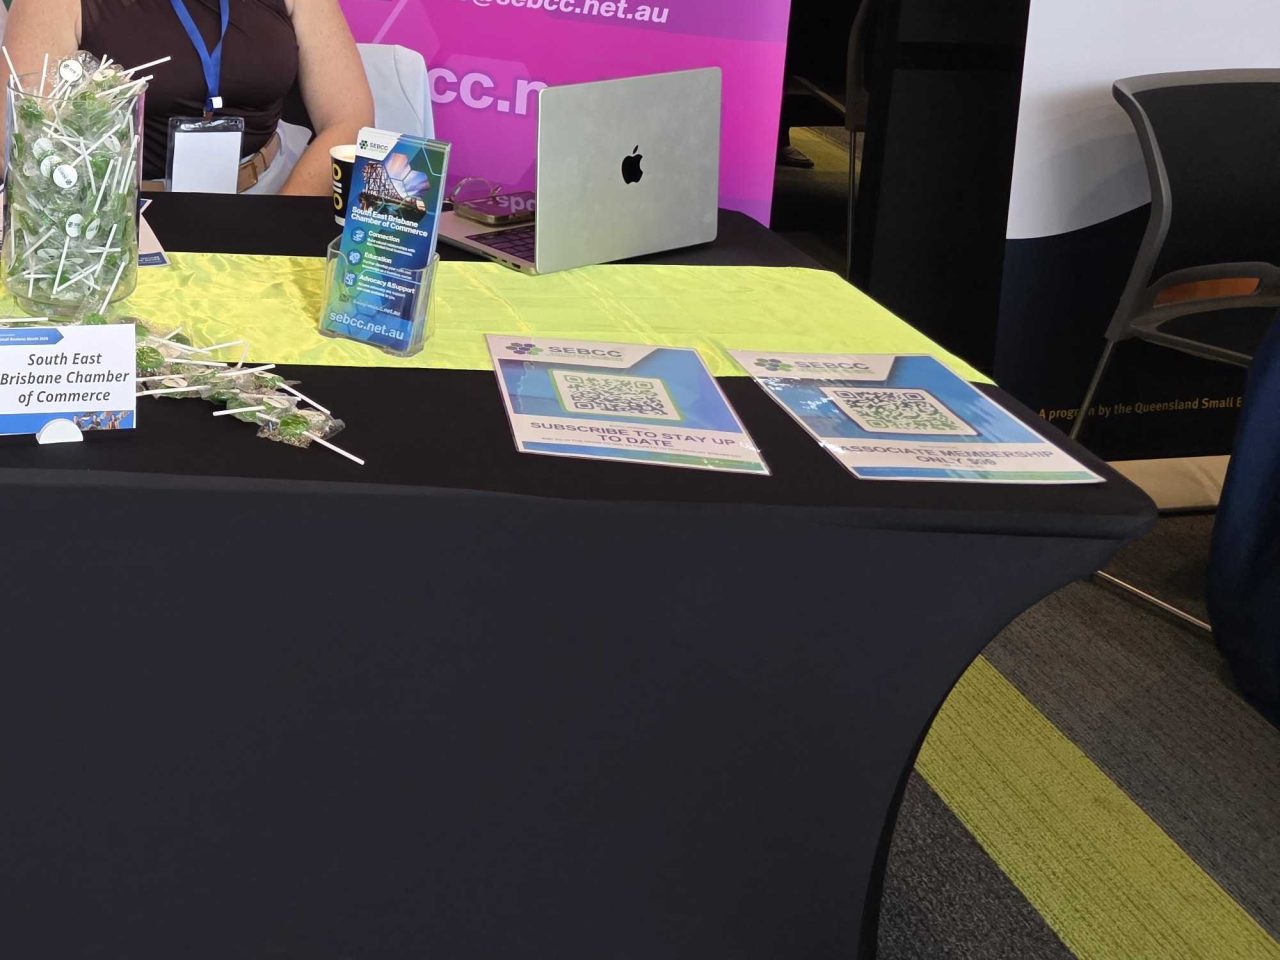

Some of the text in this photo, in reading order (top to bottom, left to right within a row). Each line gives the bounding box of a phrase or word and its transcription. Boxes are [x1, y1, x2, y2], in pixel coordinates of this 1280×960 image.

[370, 142, 389, 151] SEBCC
[351, 206, 419, 228] South East Brisbane
[351, 213, 428, 238] Chamber of Commerce
[368, 230, 401, 243] Connection
[364, 252, 392, 264] Education
[359, 274, 387, 288] Advocacy
[392, 282, 415, 295] Support
[329, 311, 405, 340] sebcc.net.au
[28, 352, 102, 366] South East
[548, 346, 623, 358] SEBCC
[794, 361, 870, 371] SEBCC
[0, 370, 130, 386] Brisbane Chamber
[18, 390, 110, 407] of Commerce
[1049, 406, 1095, 421] progrm
[1098, 403, 1112, 419] by
[1114, 402, 1132, 414] the
[1134, 398, 1199, 415] Queensland
[1201, 396, 1233, 410] Small
[530, 422, 633, 436] SUBSCRIBE
[634, 429, 657, 438] TO
[662, 431, 707, 443] STAY
[711, 437, 735, 447] UP
[599, 434, 622, 443] TO
[626, 437, 674, 448] DATE
[839, 445, 936, 456] ASSOCIATE
[938, 449, 1054, 458] MEMBERSHIP
